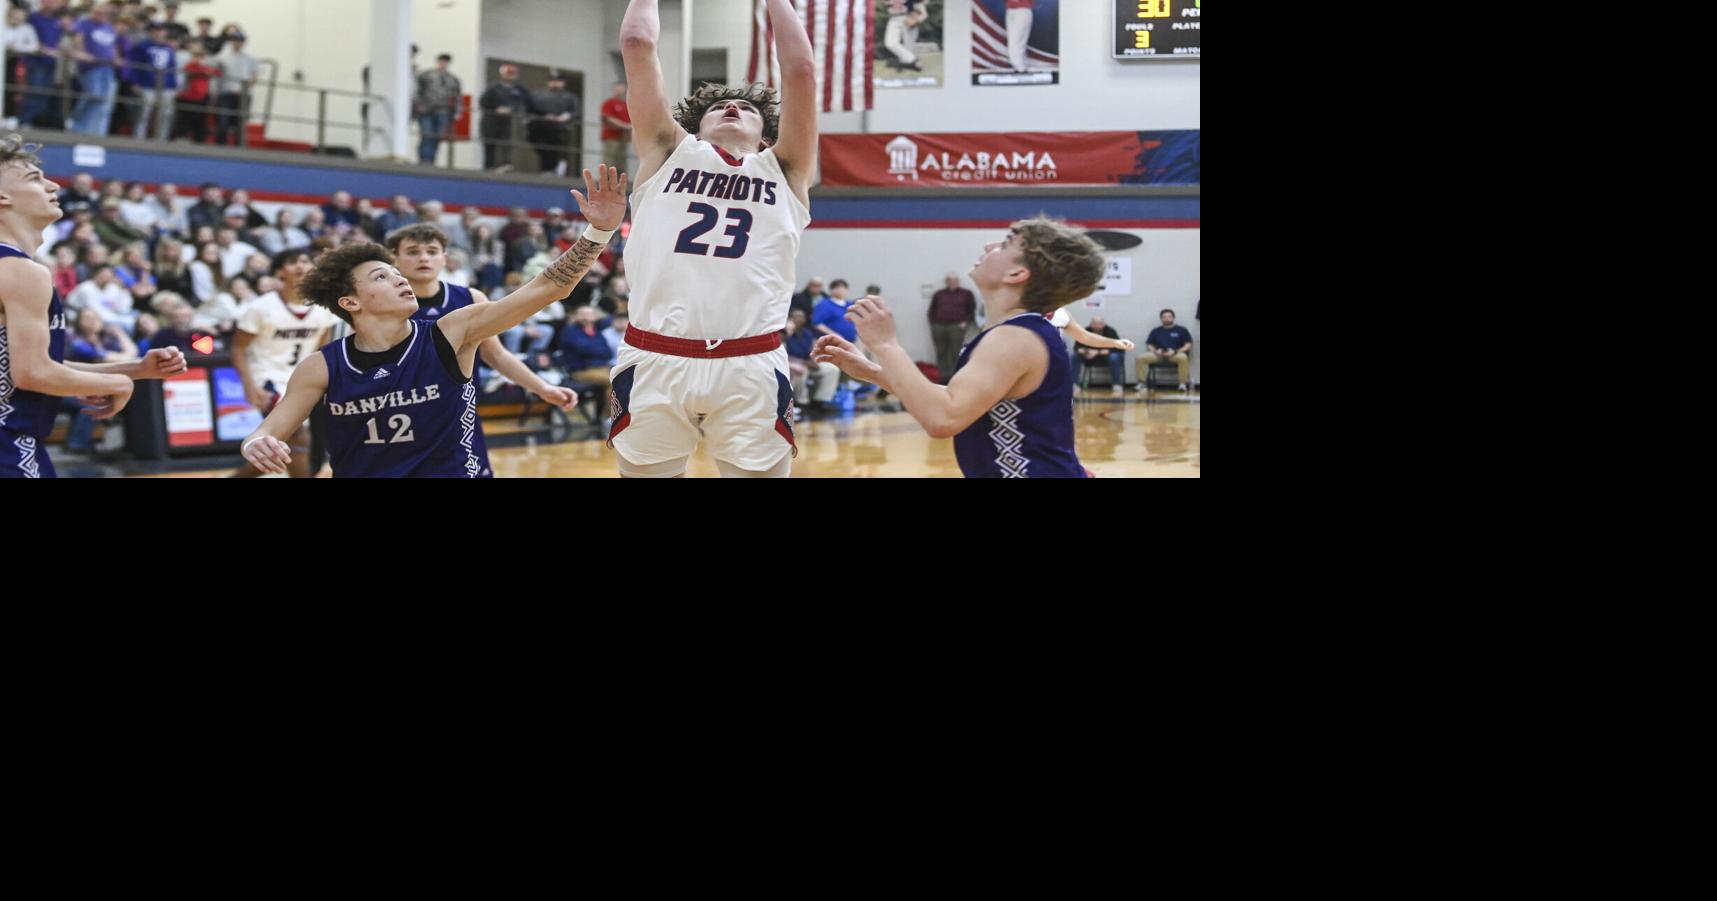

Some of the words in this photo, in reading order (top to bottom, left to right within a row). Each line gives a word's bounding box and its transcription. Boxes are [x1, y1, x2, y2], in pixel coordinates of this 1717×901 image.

[1135, 30, 1150, 48] 3
[921, 152, 1056, 170] ALABAMA
[942, 169, 997, 180] credit
[1005, 169, 1057, 180] union
[663, 167, 777, 206] PATRIOTS
[674, 201, 753, 259] 23
[329, 384, 440, 416] DANVILLE
[364, 414, 414, 444] 12
